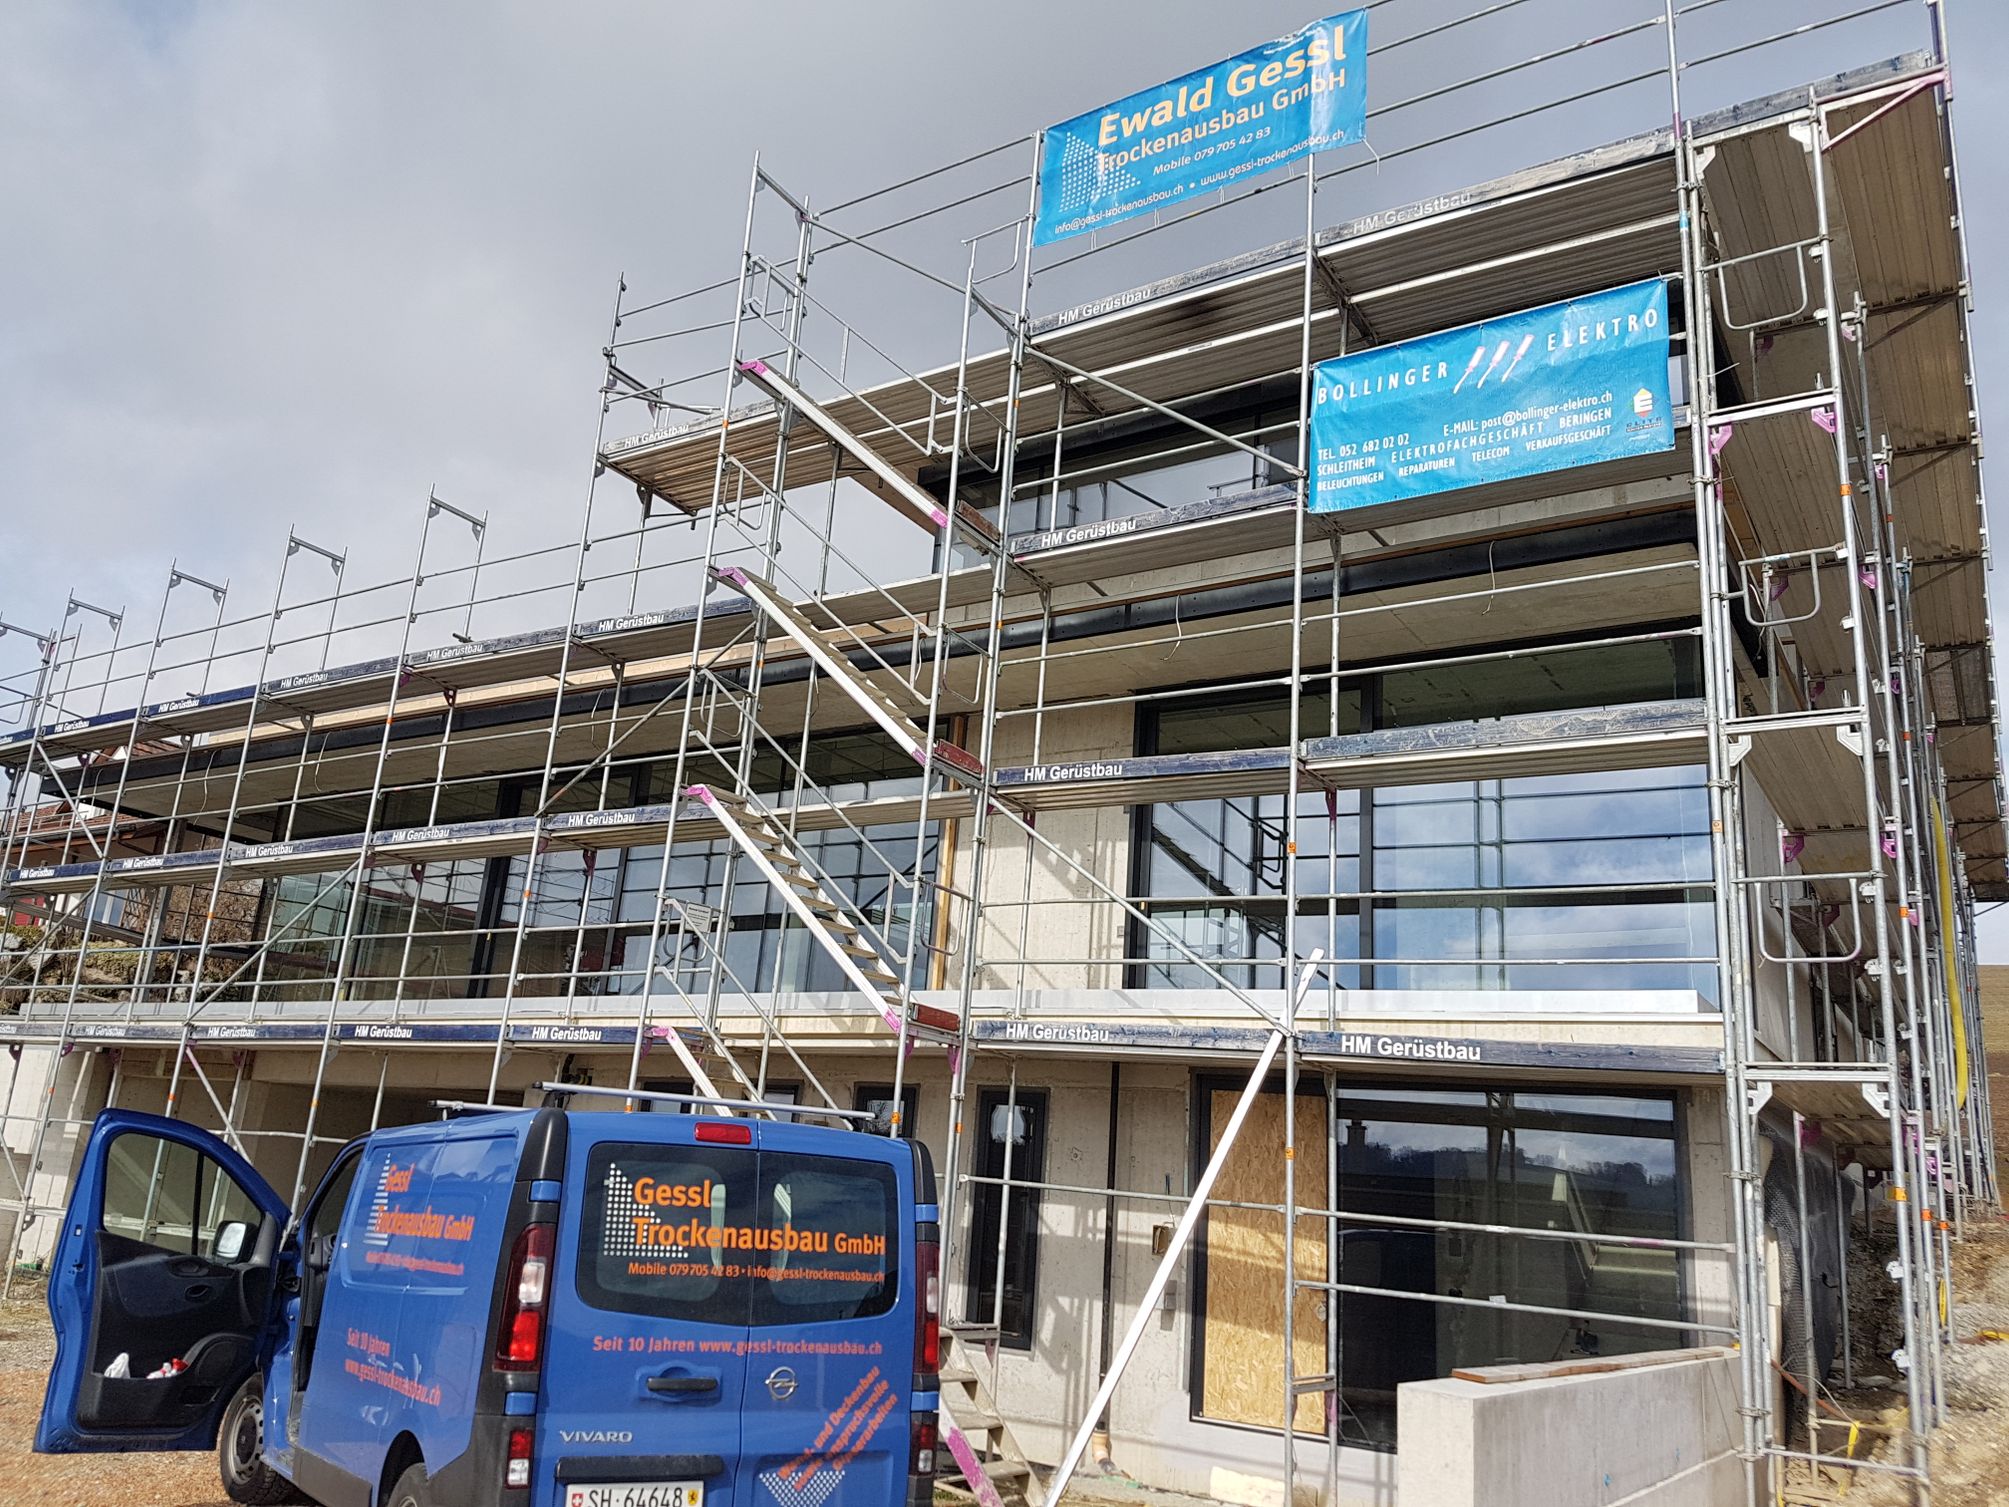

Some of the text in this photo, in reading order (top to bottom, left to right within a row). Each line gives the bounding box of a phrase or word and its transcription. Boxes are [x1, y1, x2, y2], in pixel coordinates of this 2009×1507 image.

[1098, 25, 1346, 146] Ewald Gessl
[1098, 69, 1346, 174] Trockenausbau GmbH
[1153, 126, 1271, 176] Mobile 079 705 42 83
[1055, 129, 1344, 234] info@gessl-trockenausbau.ch www.gessl-trockenausbau.ch
[1353, 193, 1470, 234] HM Gerüstbau
[1058, 289, 1150, 325] HM Gerüstbau
[1318, 308, 1658, 405] BOLLINGER ELEKTRO
[1443, 390, 1612, 437] E-MAIL: post@bollinger-elektro.ch
[624, 435, 640, 448] HM
[1317, 456, 1375, 476] SCHLEITHEIM
[1391, 421, 1543, 463] ELEKTROFACHGESCHÄFT
[1559, 407, 1612, 429] BERINGEN
[1340, 444, 1357, 457] 052
[1362, 439, 1380, 453] 682
[1383, 436, 1394, 449] 02
[1398, 433, 1409, 446] 02
[1317, 471, 1384, 492] BELEUCHTUNGEN
[1399, 457, 1455, 477] REPARATUREN
[1472, 446, 1510, 462] TELECOM
[1525, 425, 1611, 451] VERKAUFSGESCHÄFT
[1041, 520, 1136, 548] HM Gerüstbau
[599, 614, 664, 632] HM Gerüstbau
[281, 672, 328, 688] HM Gerüstbau
[1024, 763, 1122, 781] HM Gerüstbau
[568, 812, 635, 827] HM Gerüstbau
[392, 828, 450, 841] HM Gerüstbau
[245, 845, 293, 857] HM Gerüstbau
[208, 1027, 219, 1036] HM
[355, 1026, 413, 1038] HM Gerüstbau
[532, 1026, 602, 1041] HM Gerüstbau
[1006, 1023, 1109, 1041] HM Gerüstbau
[1341, 1035, 1481, 1061] HM Gerüstbau
[634, 1177, 712, 1208] Gessl
[444, 1214, 475, 1241] GmbH
[631, 1217, 886, 1255] Trockenausbau GmbH
[628, 1262, 667, 1276] Mobile
[669, 1263, 688, 1276] 079
[689, 1264, 709, 1276] 705
[725, 1264, 740, 1277] 83
[593, 1335, 882, 1357] Seit 10 Jahren www.gessl-trockenausbau.ch
[560, 1430, 633, 1443] VIVARO
[588, 1486, 683, 1507] SH 64648
